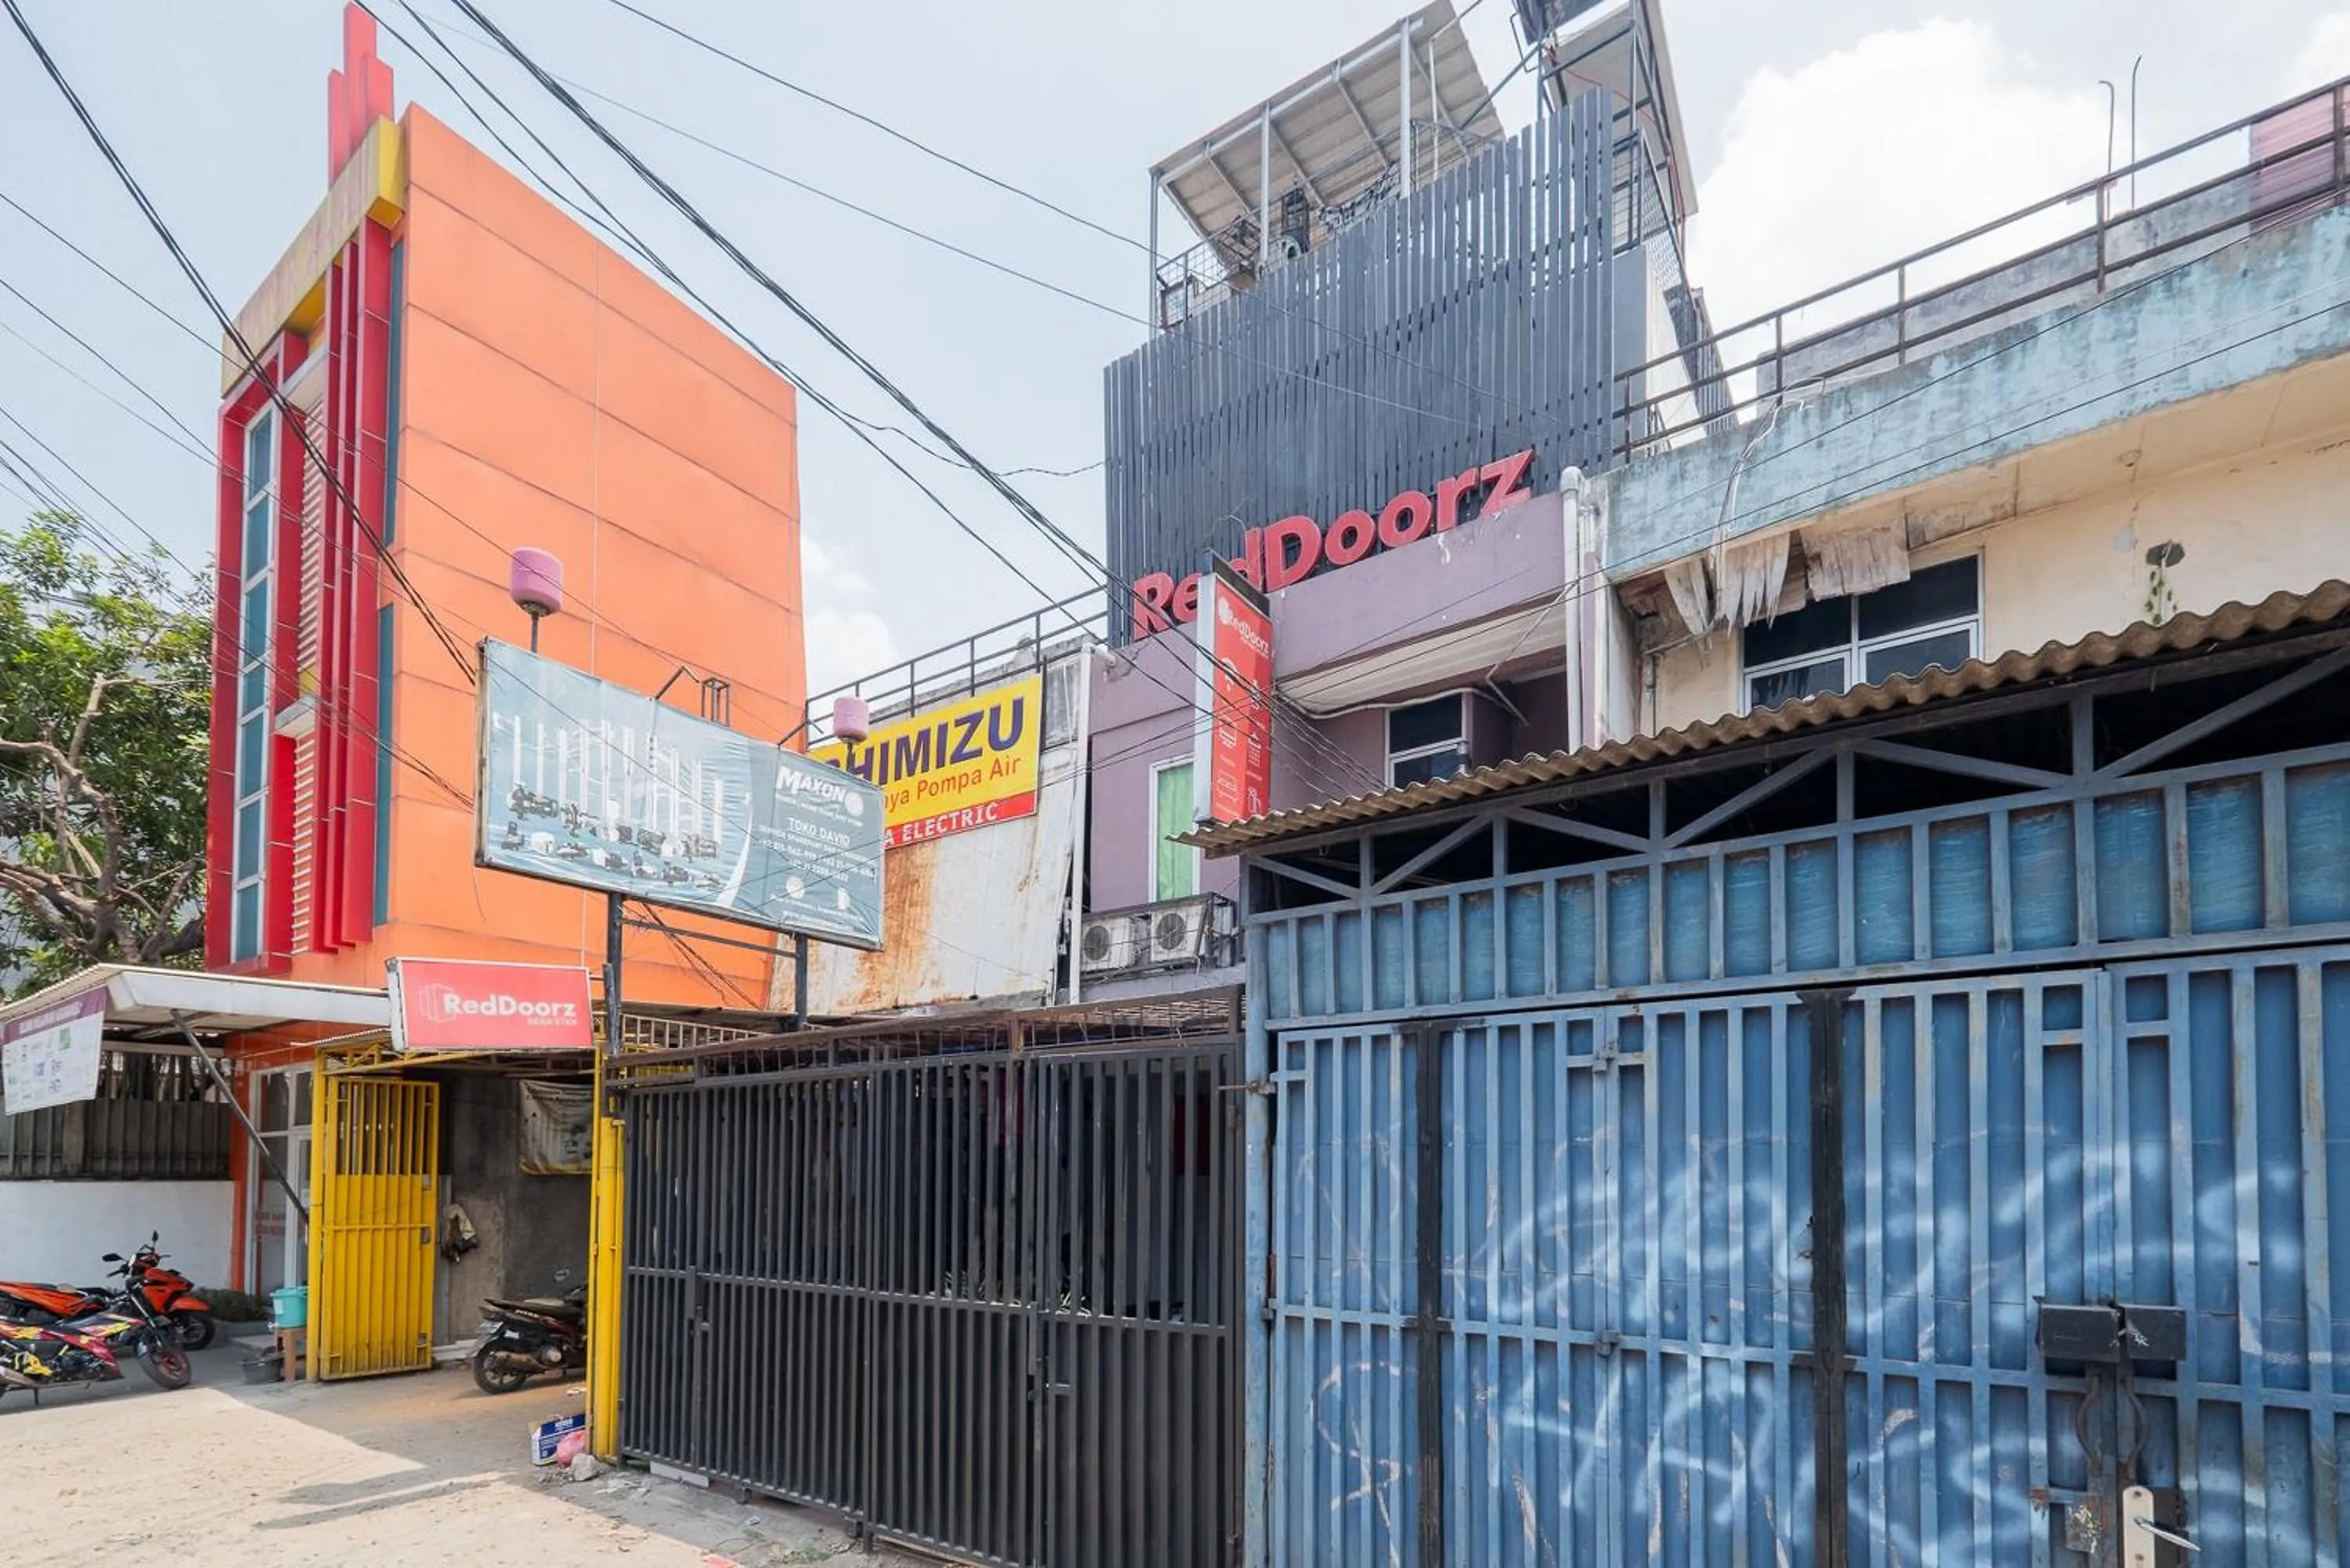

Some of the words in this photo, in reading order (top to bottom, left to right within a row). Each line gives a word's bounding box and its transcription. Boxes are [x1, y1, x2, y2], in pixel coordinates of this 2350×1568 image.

[1133, 449, 1535, 642] RedDoorz
[825, 695, 1024, 787] HIMIZU
[916, 768, 982, 800] Pompa
[989, 754, 1021, 781] Air
[788, 817, 816, 836] TOKO
[902, 801, 999, 843] ELECTRIC
[443, 992, 577, 1017] RedDoorz
